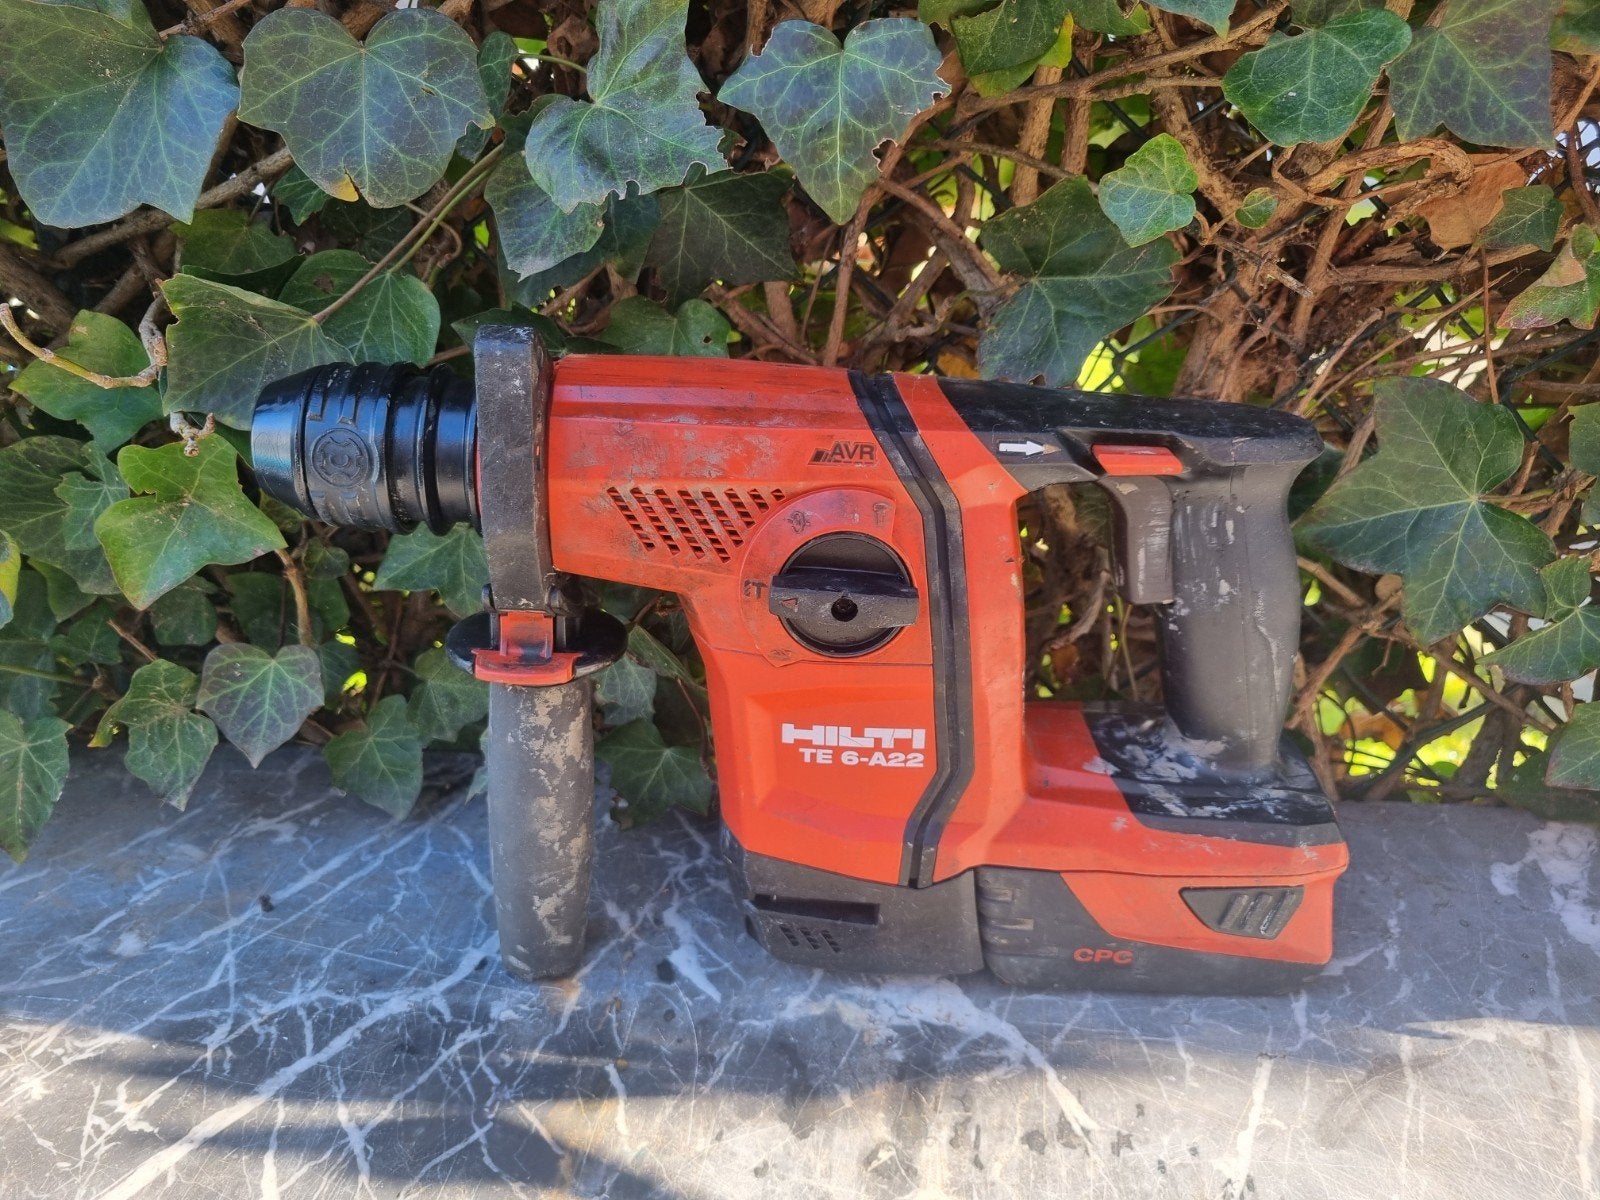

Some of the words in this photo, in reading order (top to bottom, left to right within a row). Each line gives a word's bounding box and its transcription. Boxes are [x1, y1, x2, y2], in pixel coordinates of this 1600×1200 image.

[830, 442, 875, 461] AVR
[781, 723, 926, 749] HILTI
[798, 748, 833, 764] TE
[840, 750, 924, 768] 6-A22
[1073, 948, 1134, 964] CPC
